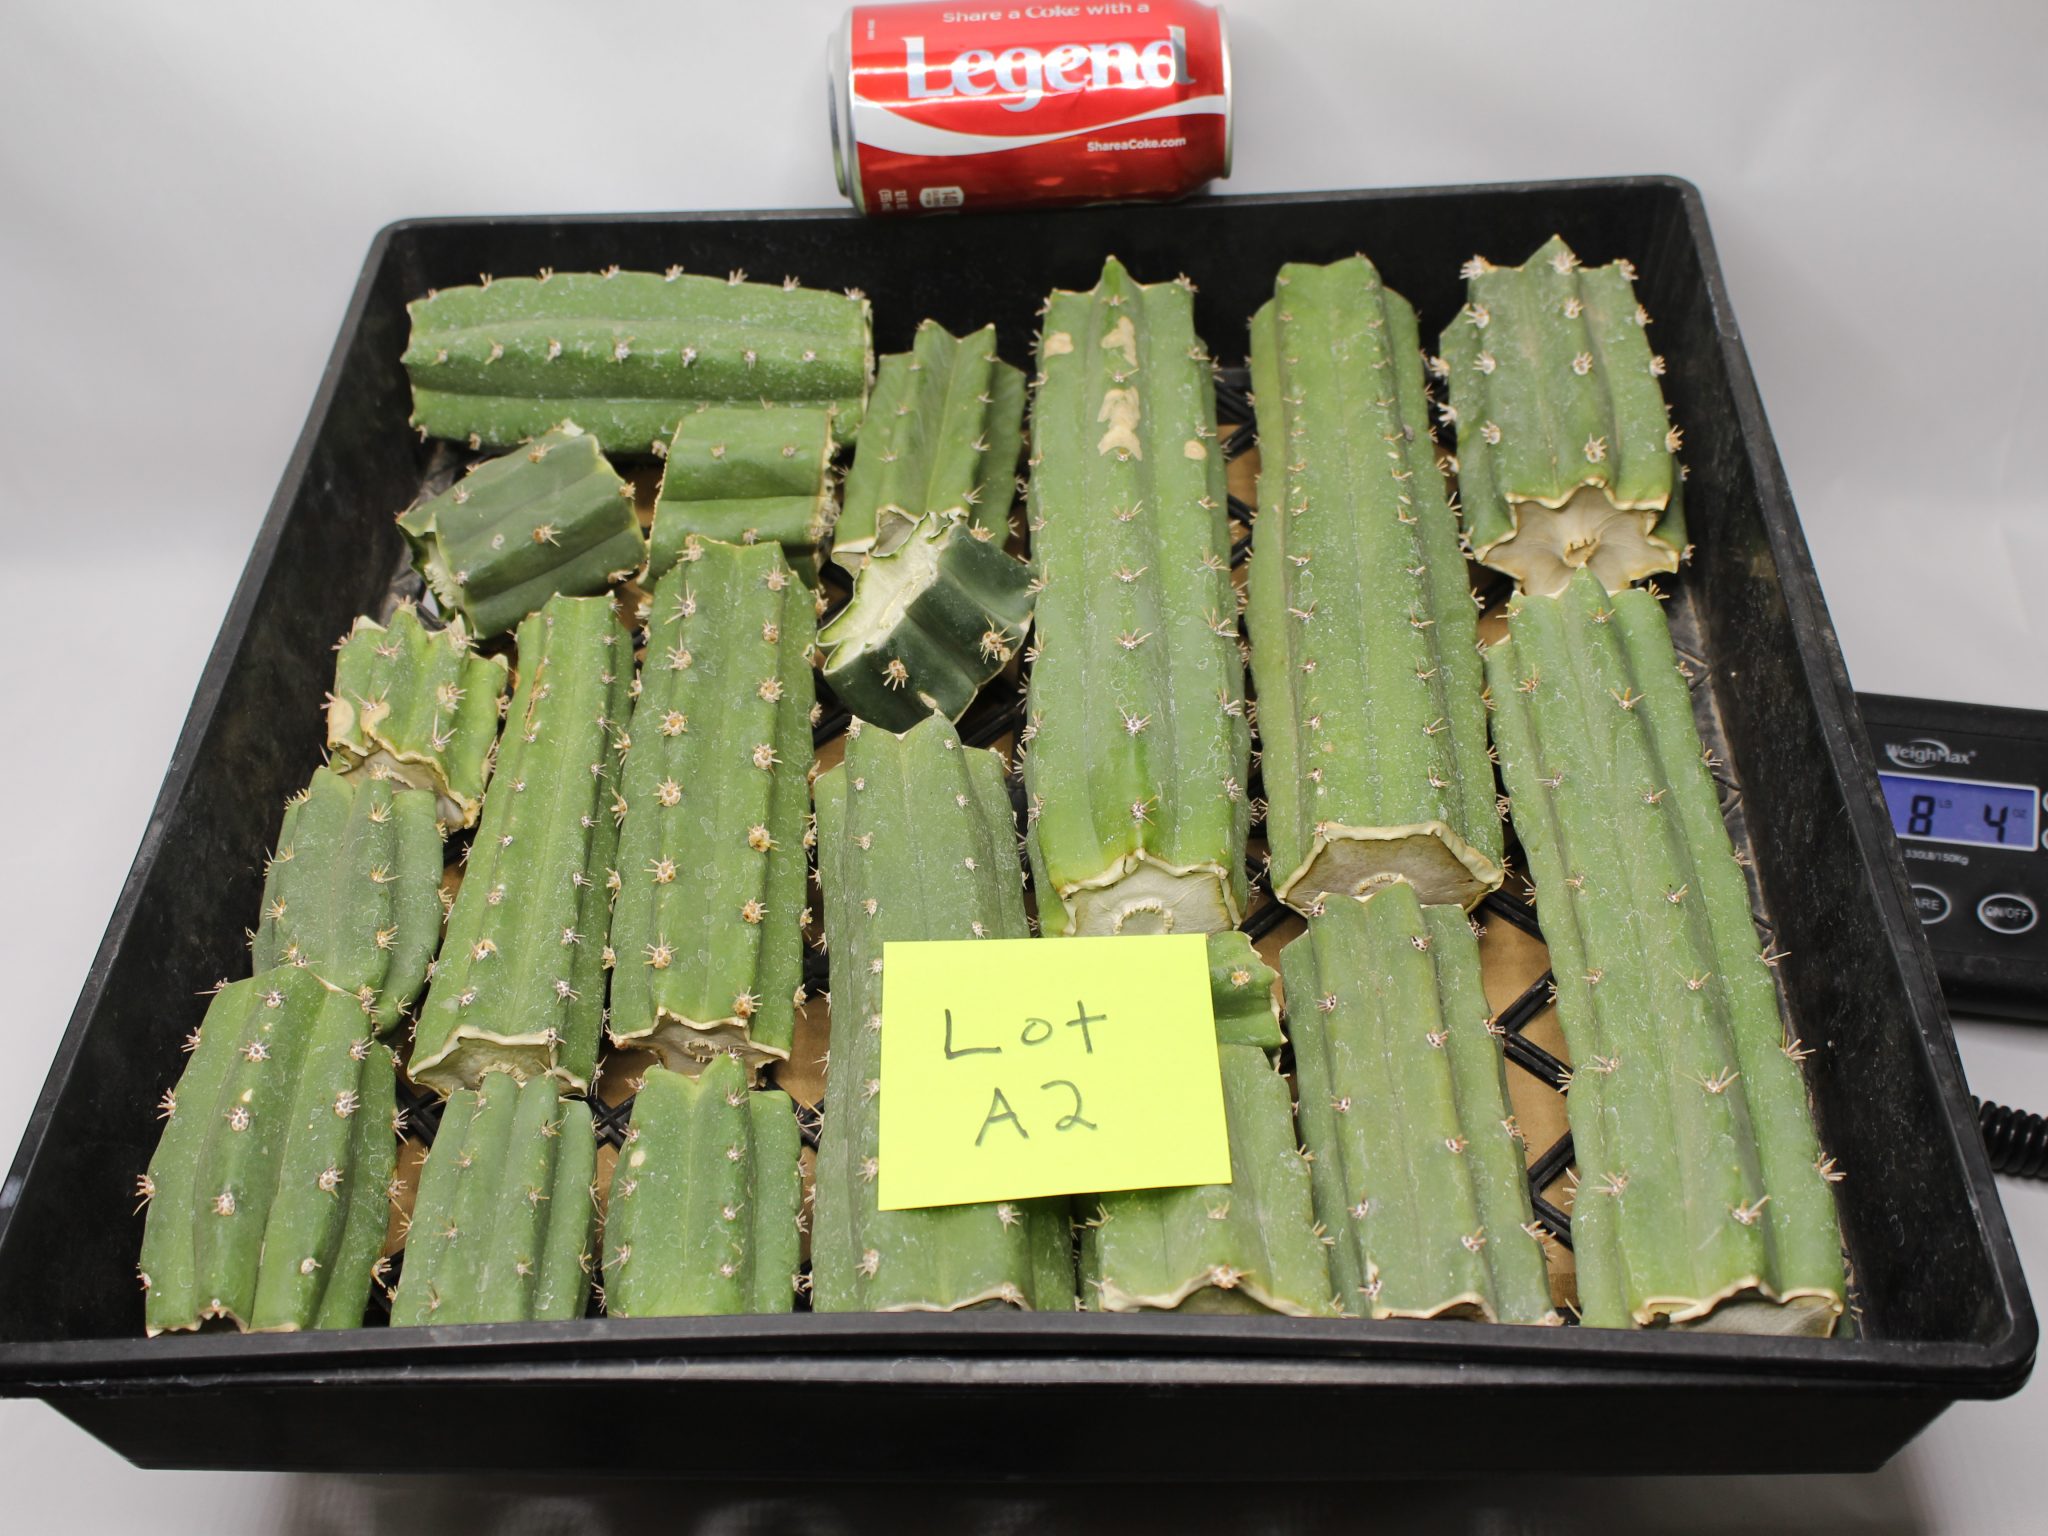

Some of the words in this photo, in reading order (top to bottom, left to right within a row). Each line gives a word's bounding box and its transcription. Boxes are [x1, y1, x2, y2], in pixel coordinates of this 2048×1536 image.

[943, 9, 1002, 23] Share
[1008, 10, 1020, 20] a
[1025, 5, 1080, 19] Coke
[1086, 3, 1132, 15] with
[1137, 3, 1150, 13] a
[901, 25, 1196, 112] Legend
[1087, 137, 1186, 152] ShareaCoke.com
[1908, 795, 1936, 836] 8
[1984, 804, 2009, 843] 4
[1914, 898, 1940, 910] RE
[944, 1000, 1107, 1060] Lot
[975, 1080, 1098, 1146] A2
